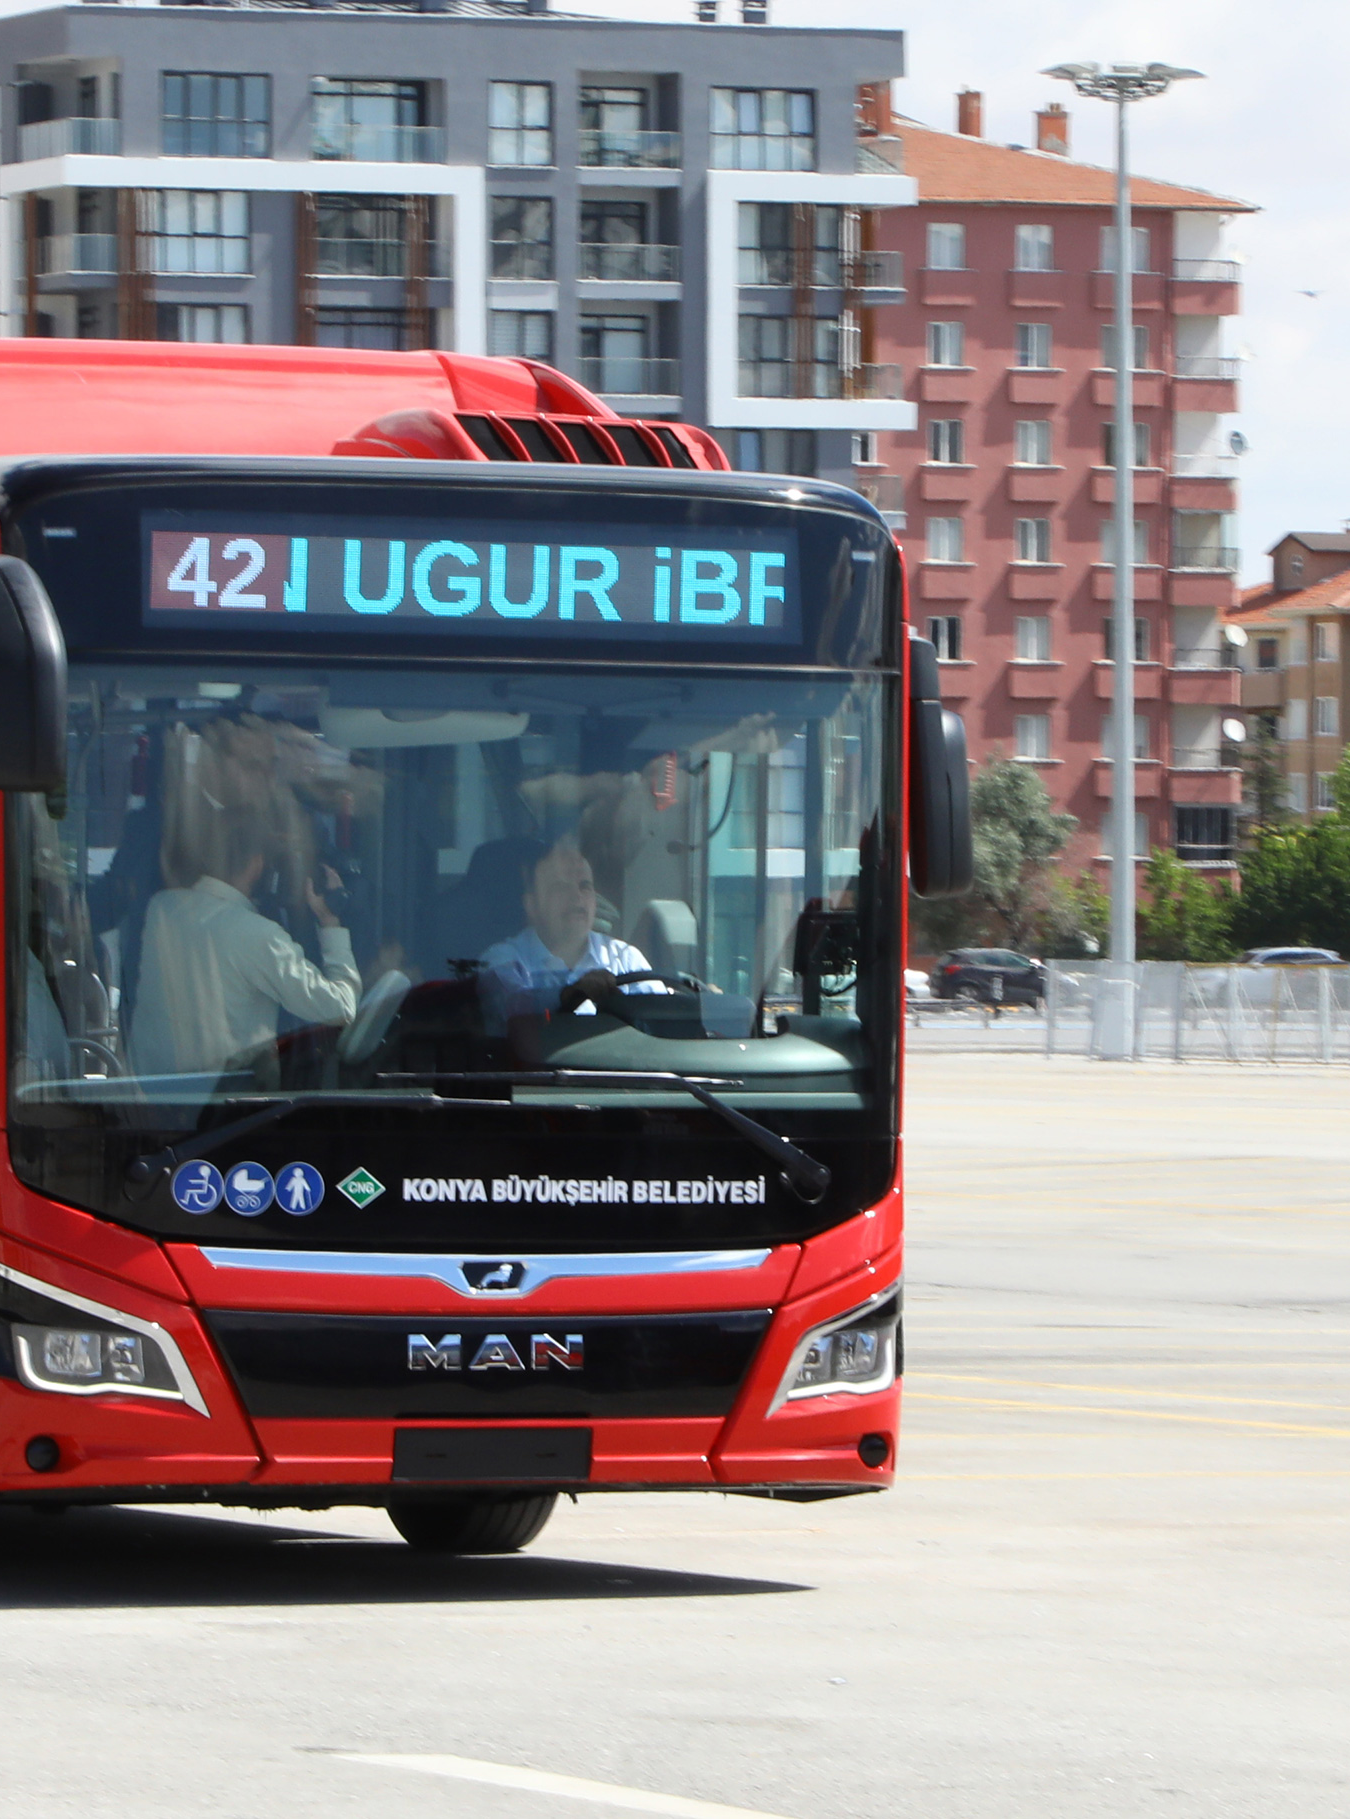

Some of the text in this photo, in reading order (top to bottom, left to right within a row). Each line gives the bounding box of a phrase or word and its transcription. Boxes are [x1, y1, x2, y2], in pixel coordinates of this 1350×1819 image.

[167, 537, 266, 608] 42
[343, 538, 623, 622] UGUR
[347, 1180, 375, 1195] CNG
[402, 1174, 766, 1206] KONYA BÜYÜKŞEHİR BELEDİYESİ
[407, 1333, 584, 1371] MAN
